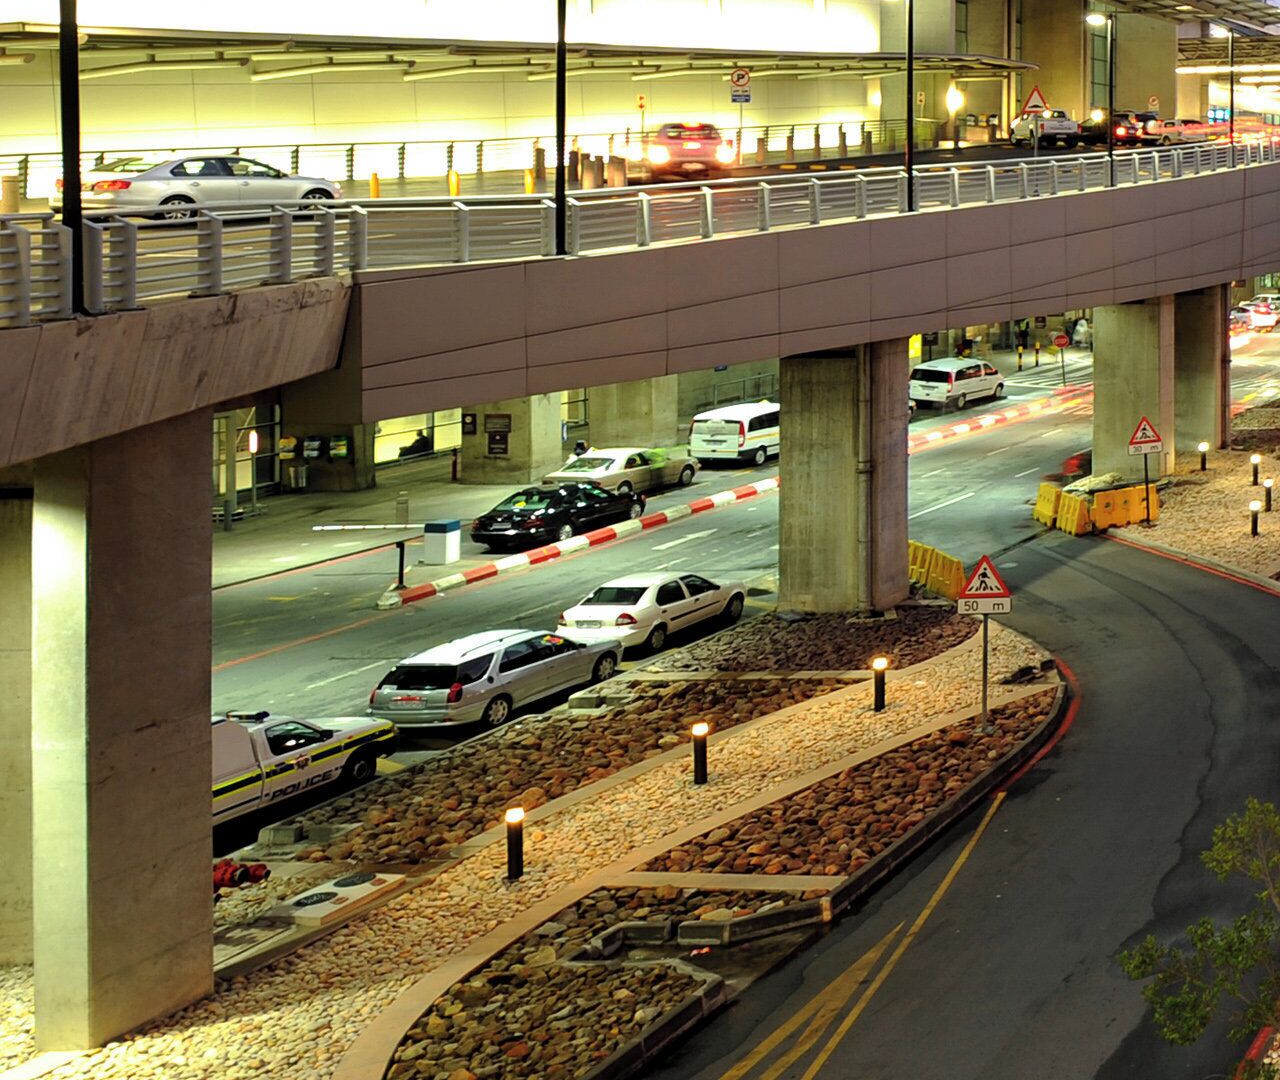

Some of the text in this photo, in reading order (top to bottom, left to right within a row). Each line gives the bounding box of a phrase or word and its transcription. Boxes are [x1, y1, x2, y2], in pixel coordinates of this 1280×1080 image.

[964, 600, 1005, 611] 50 m
[270, 769, 333, 801] POLICE
